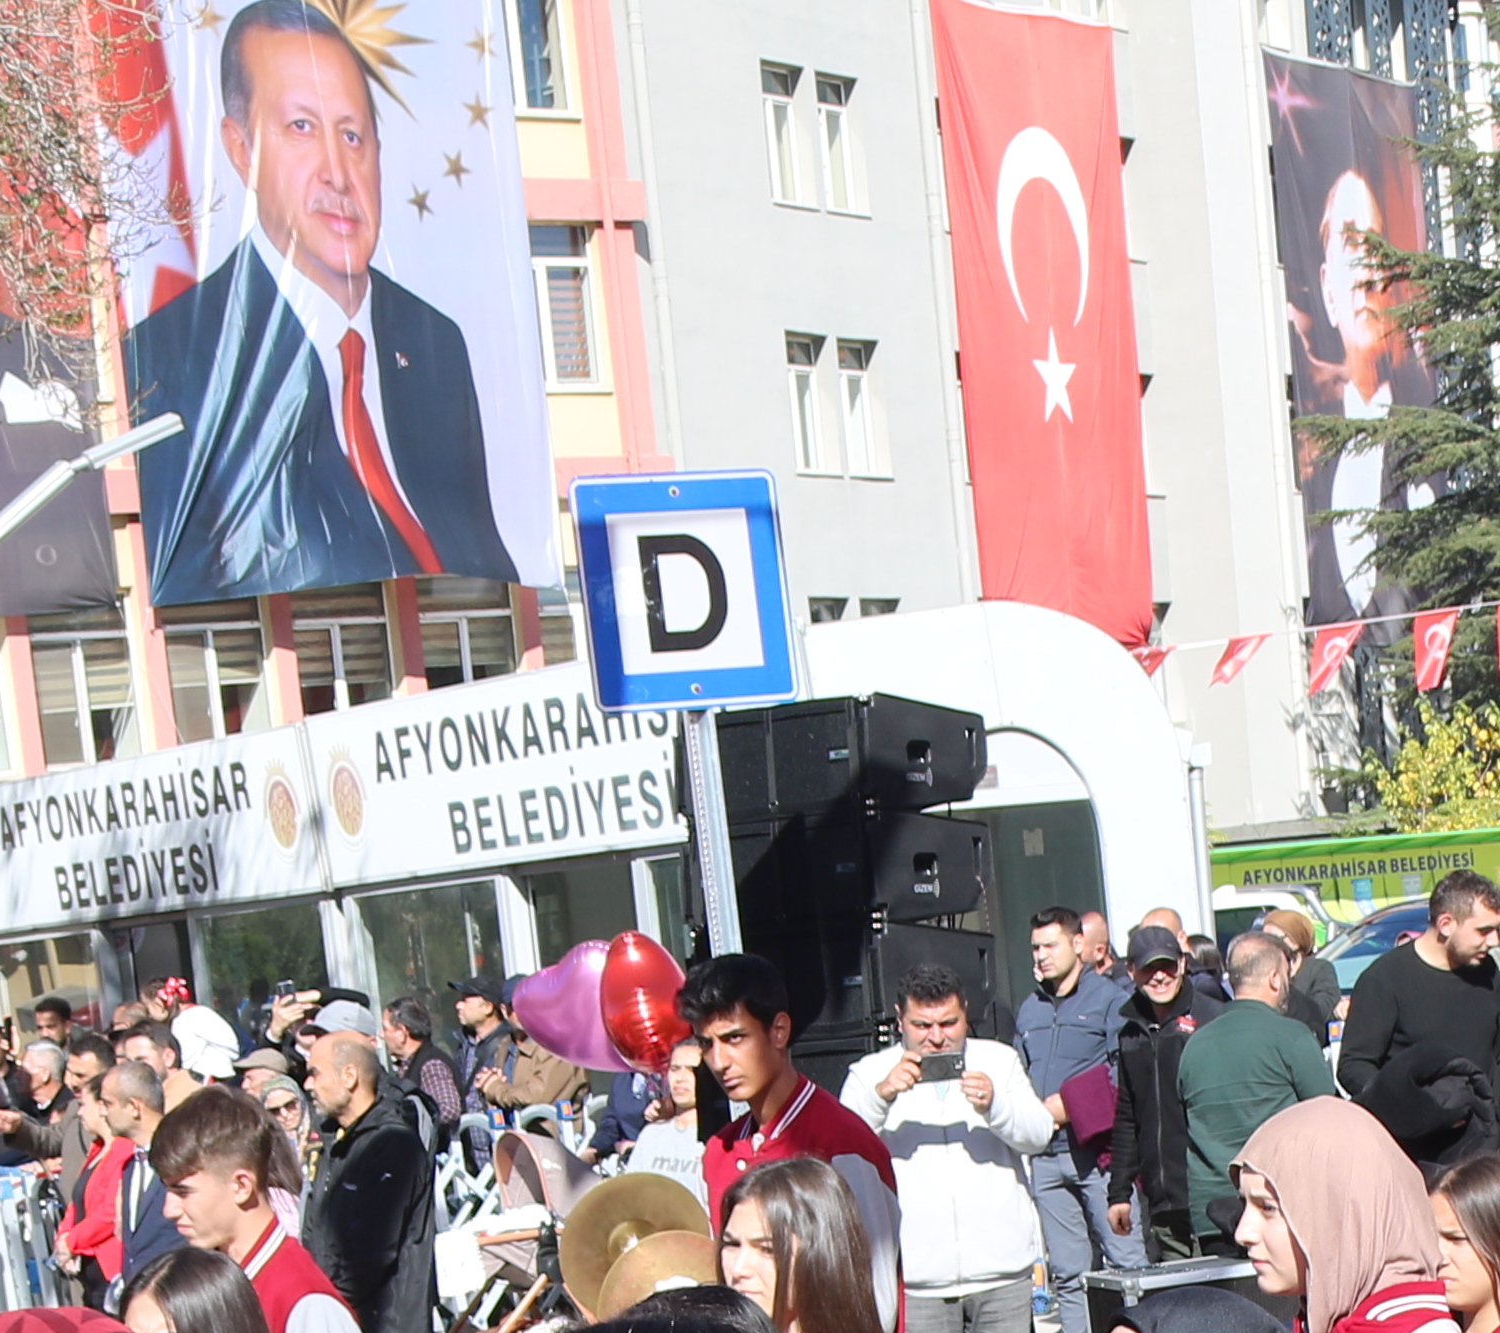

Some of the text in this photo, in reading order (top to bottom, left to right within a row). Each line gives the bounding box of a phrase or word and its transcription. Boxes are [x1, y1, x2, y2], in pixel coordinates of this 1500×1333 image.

[637, 534, 728, 653] D
[0, 758, 252, 850] AFYONKARAHİSAR
[448, 751, 681, 854] BELEDİYESİ
[55, 829, 219, 910] BELEDİYESİ
[1243, 848, 1475, 886] AFYONKARAHİSAR BELEDİYESİ
[651, 1156, 700, 1174] mavi
